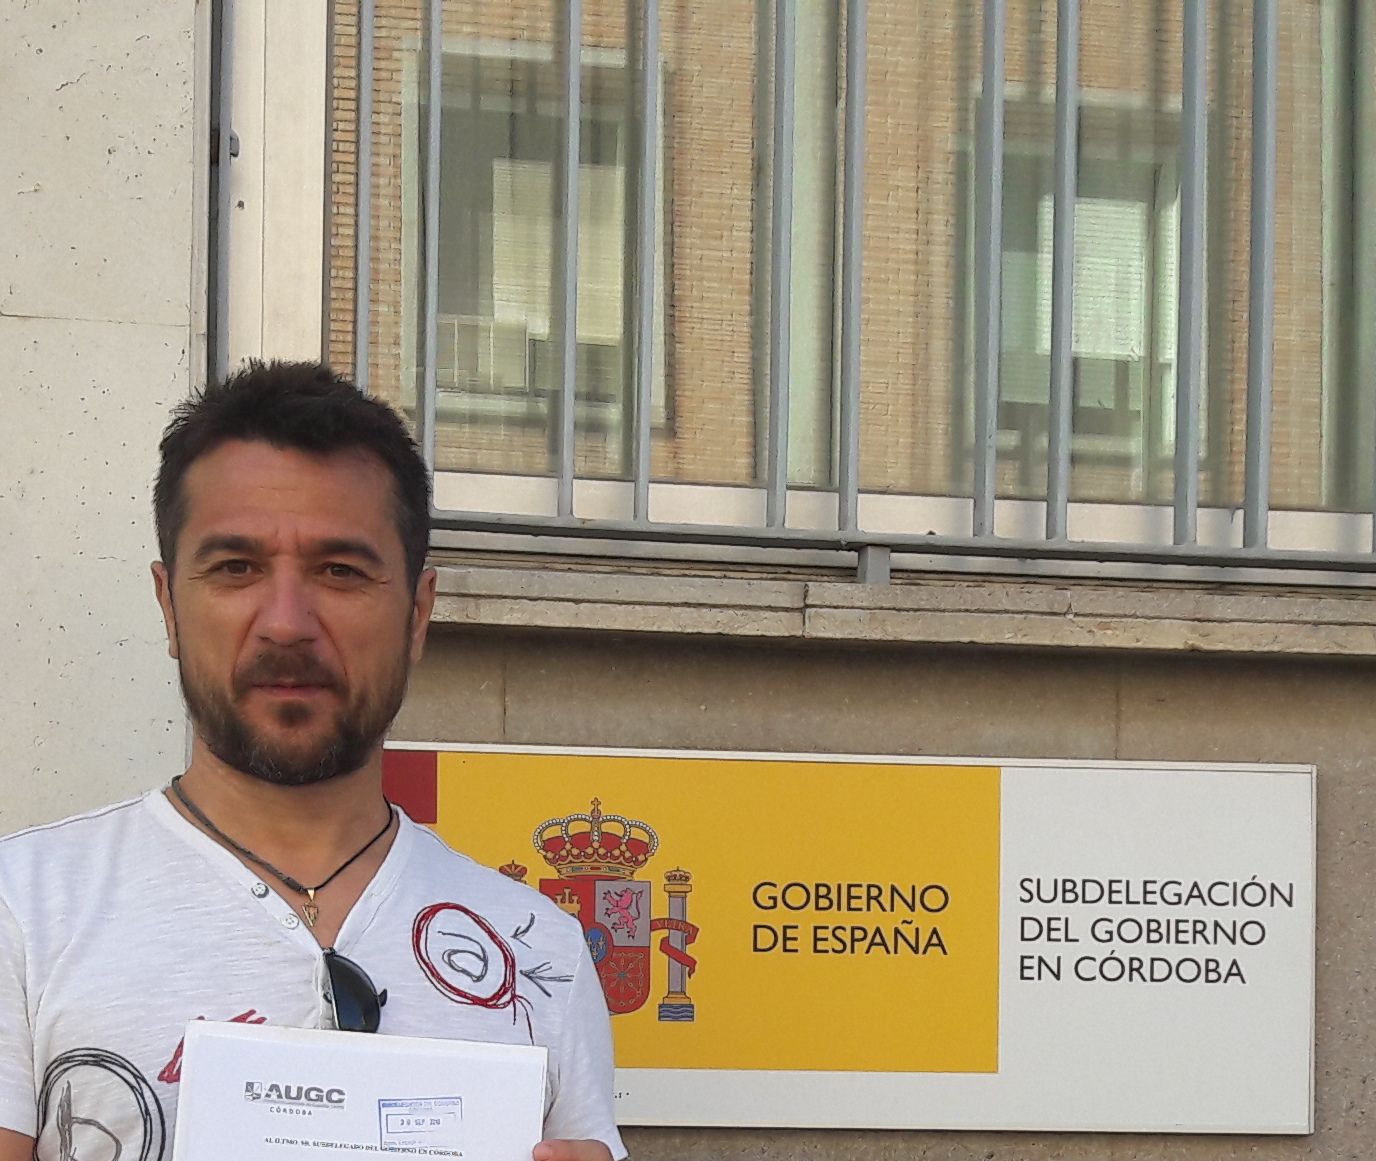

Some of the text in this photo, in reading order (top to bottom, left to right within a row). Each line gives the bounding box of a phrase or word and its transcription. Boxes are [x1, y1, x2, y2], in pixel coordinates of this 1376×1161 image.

[753, 882, 949, 912] GOBIERNO
[1020, 876, 1292, 907] SUBDELEGACIÓN
[753, 920, 947, 955] DE ESPAÑA
[1021, 917, 1265, 945] DEL GOBIERNO
[1020, 950, 1245, 983] EN CÓRDOBA
[264, 1083, 346, 1104] AUGC
